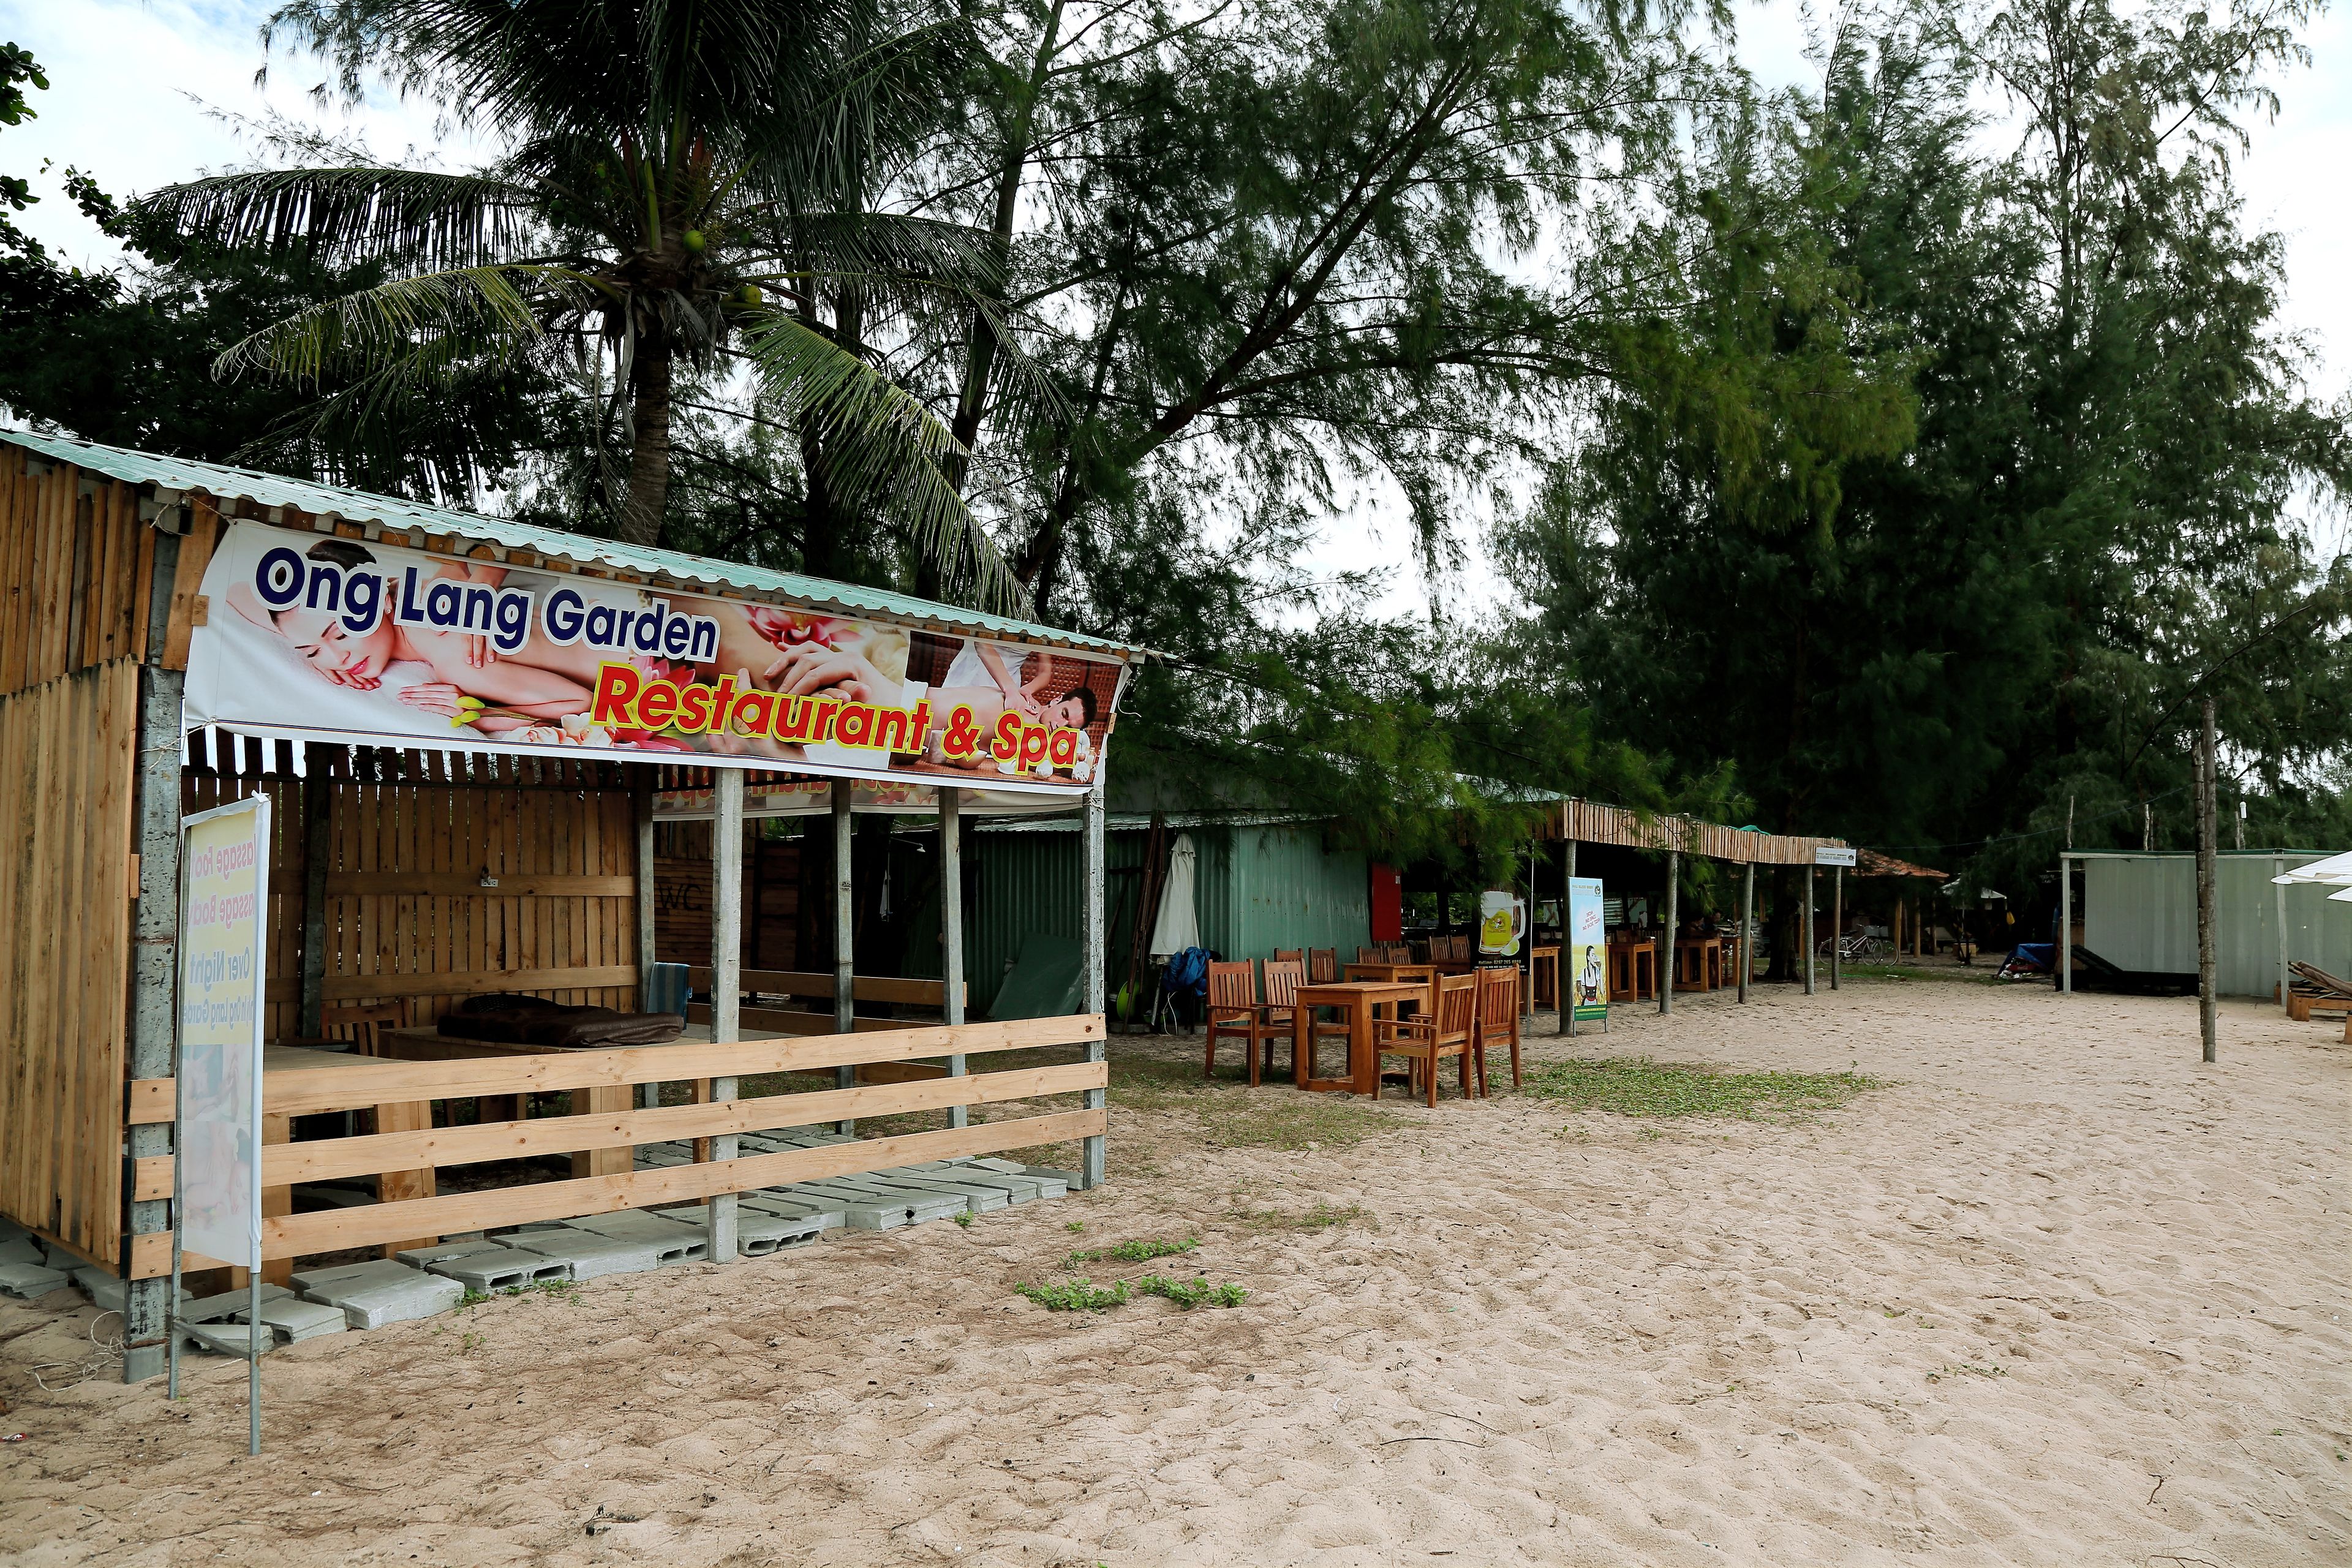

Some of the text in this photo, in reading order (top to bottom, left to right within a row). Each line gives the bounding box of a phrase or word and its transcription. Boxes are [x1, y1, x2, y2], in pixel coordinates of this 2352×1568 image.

[254, 546, 718, 659] Ong Lang Garden
[593, 665, 1077, 773] Restaurant & Spa
[657, 882, 704, 911] WC
